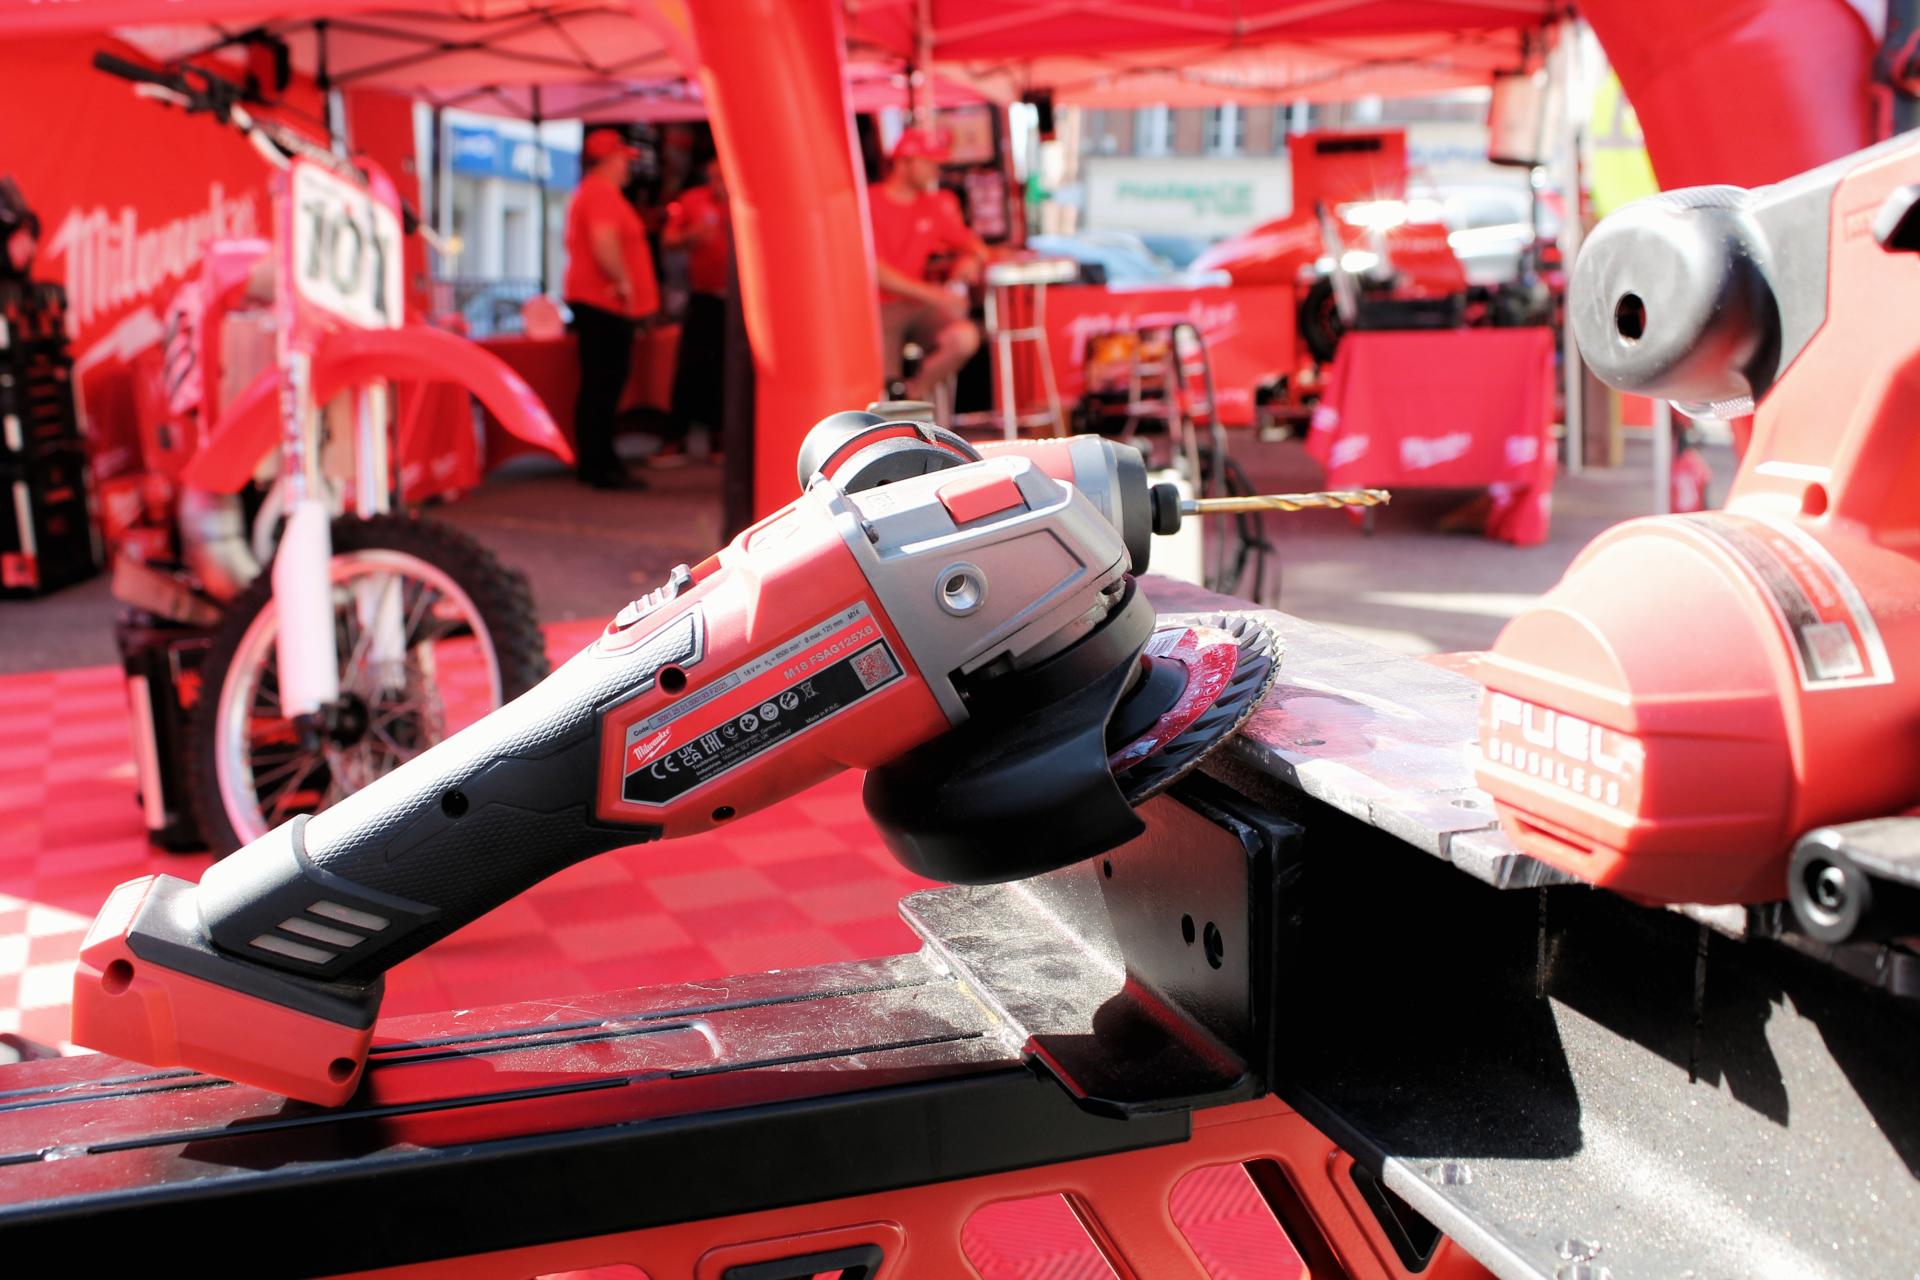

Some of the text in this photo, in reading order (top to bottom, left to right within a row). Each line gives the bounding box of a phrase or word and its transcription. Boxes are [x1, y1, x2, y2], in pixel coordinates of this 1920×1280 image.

[300, 196, 390, 322] 101
[848, 610, 860, 619] M14
[783, 662, 808, 679] M18
[633, 728, 671, 760] Milwaukee
[1491, 693, 1623, 775] FUEL
